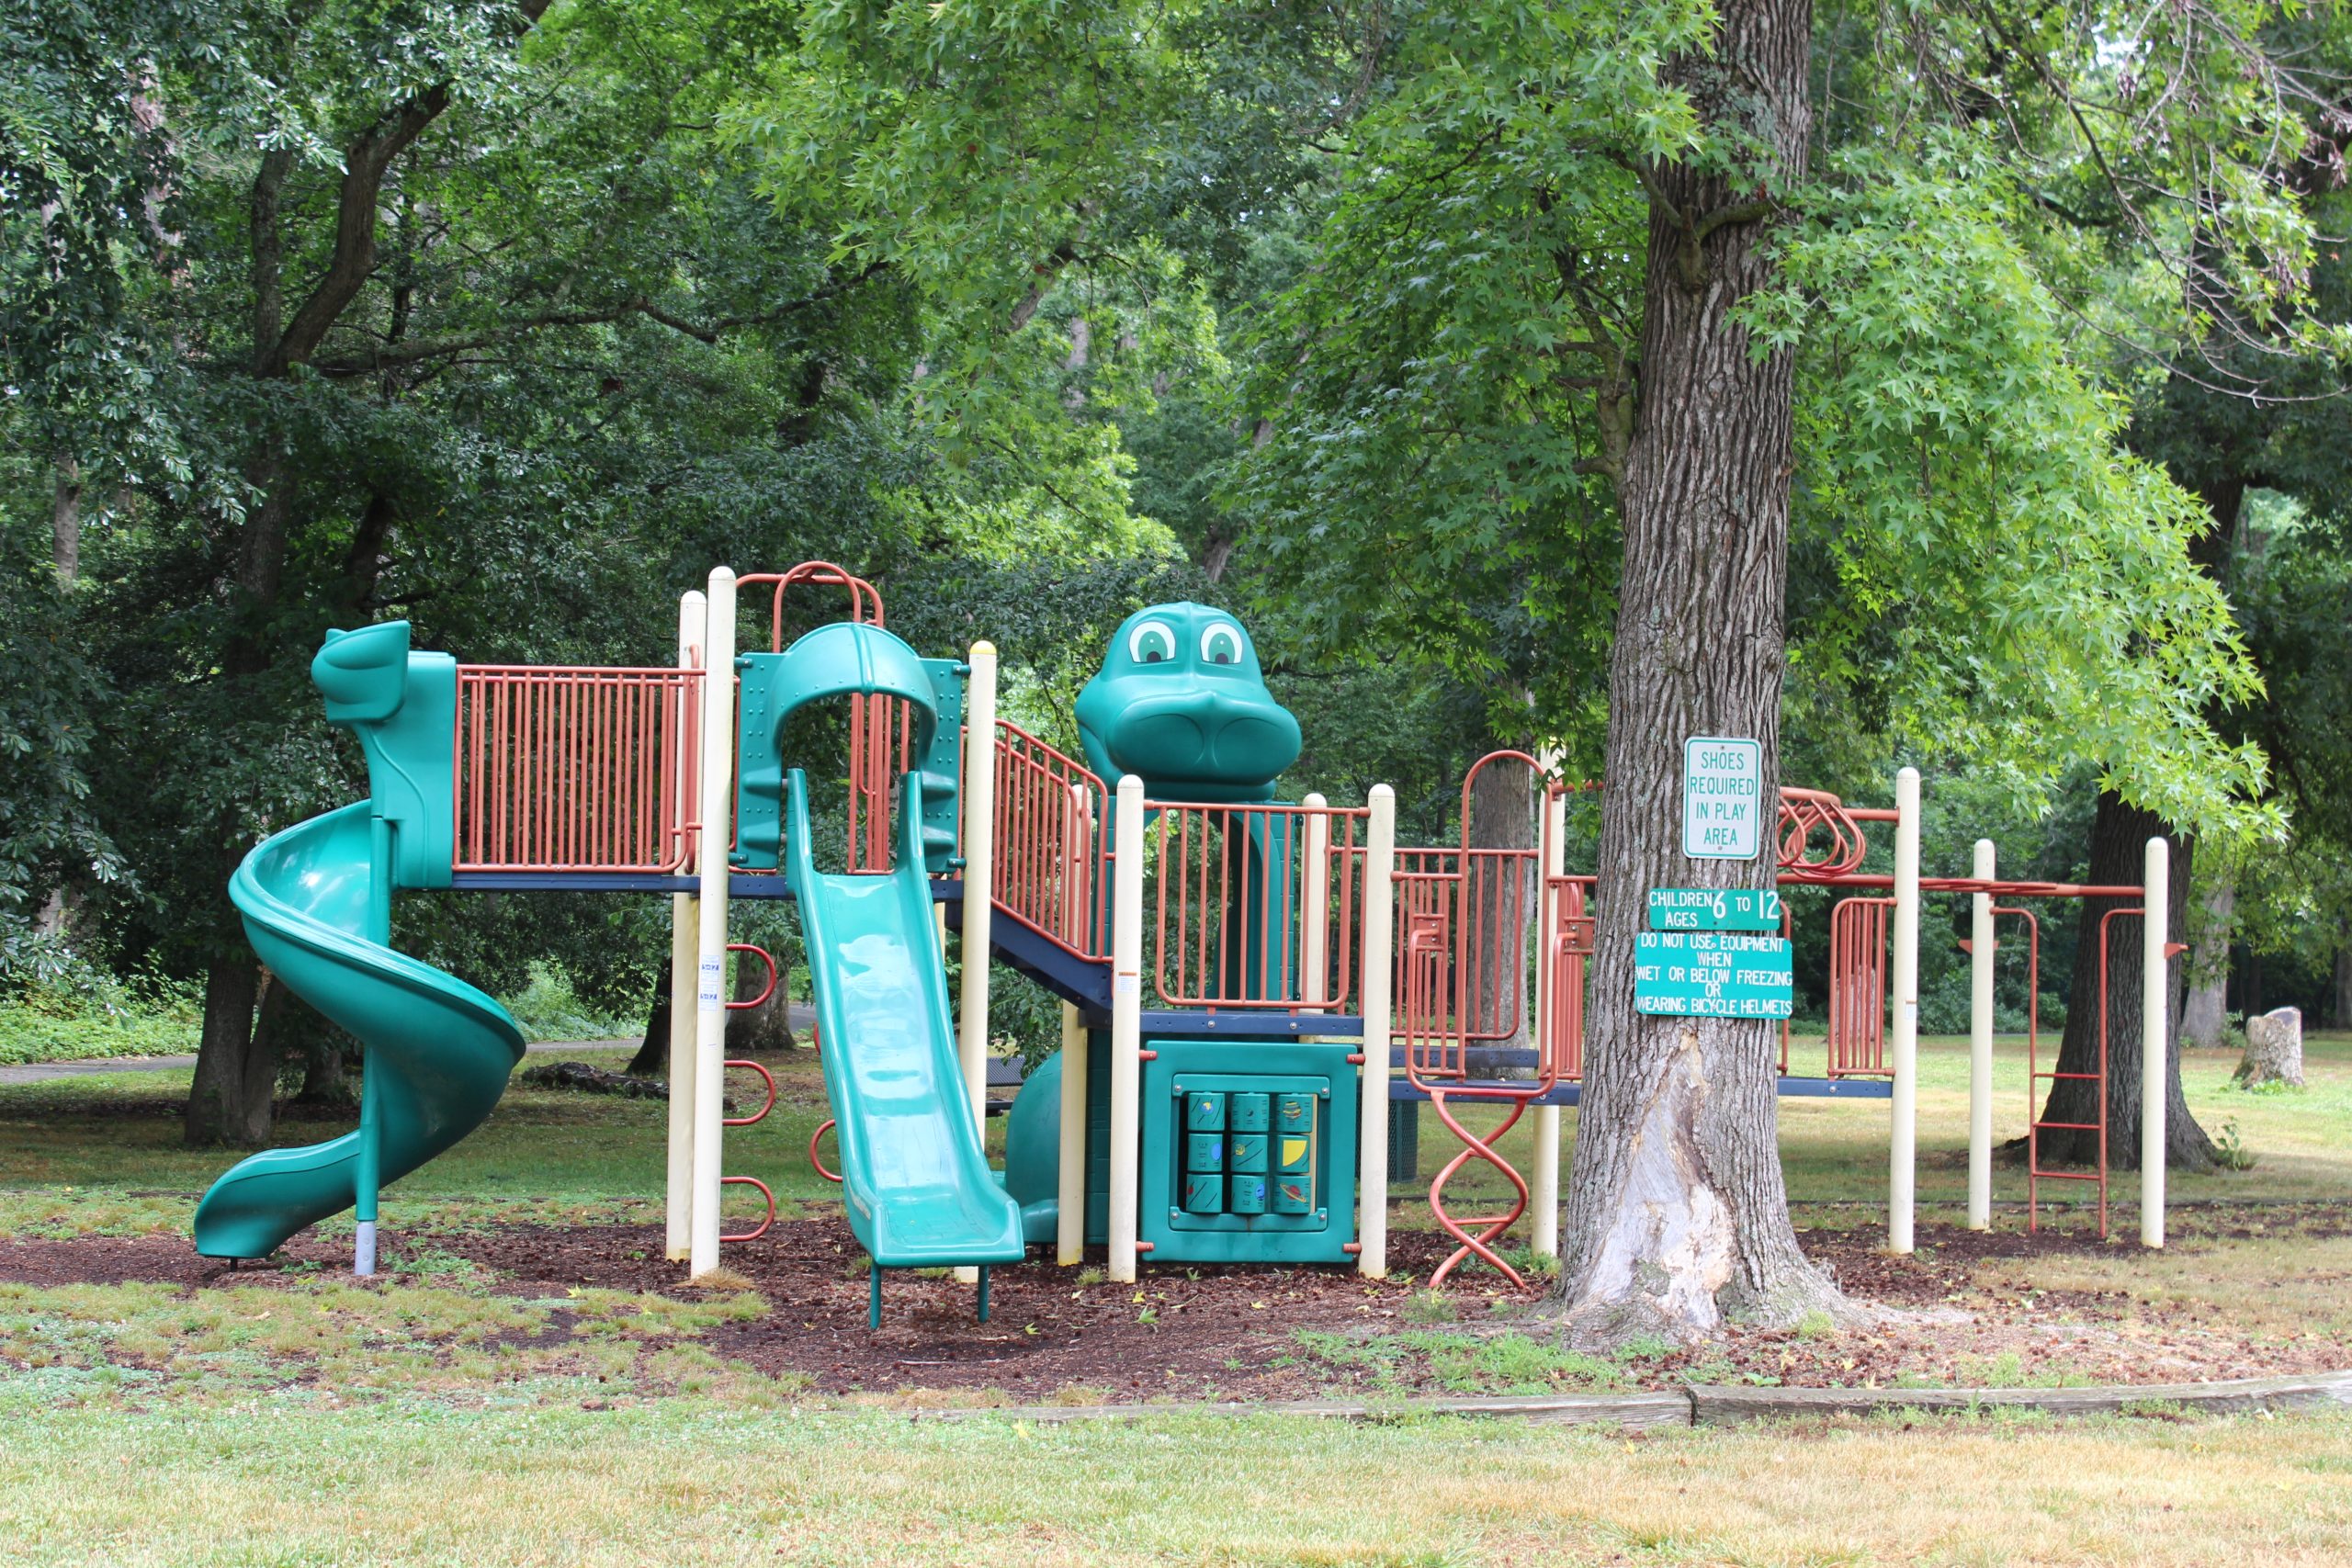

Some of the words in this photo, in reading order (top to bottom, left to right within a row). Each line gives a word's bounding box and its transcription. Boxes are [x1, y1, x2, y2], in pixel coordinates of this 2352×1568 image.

[1701, 751, 1744, 770] SHOES
[1690, 776, 1755, 795] REQUIRED
[1696, 802, 1708, 819] IN
[1715, 803, 1747, 820] PLAY
[1703, 828, 1737, 845] AREA
[1649, 891, 1713, 907] CHILDREN
[1713, 890, 1726, 919] 6
[1736, 897, 1751, 911] TO
[1758, 891, 1780, 919] 12
[1665, 912, 1698, 928] AGES
[1641, 932, 1657, 948] DO
[1662, 933, 1685, 948] NOT
[1690, 934, 1713, 949] USE
[1720, 936, 1784, 953] EQUIPMENT
[1697, 952, 1732, 967] WHEN
[1635, 966, 1660, 981] WET
[1668, 966, 1685, 982] OR
[1690, 968, 1730, 984] BELOW
[1736, 970, 1792, 987] FREEZING
[1705, 983, 1721, 998] OR
[1637, 996, 1686, 1012] WEARING
[1691, 998, 1736, 1015] BICYCLE
[1740, 999, 1792, 1016] HELMETS
